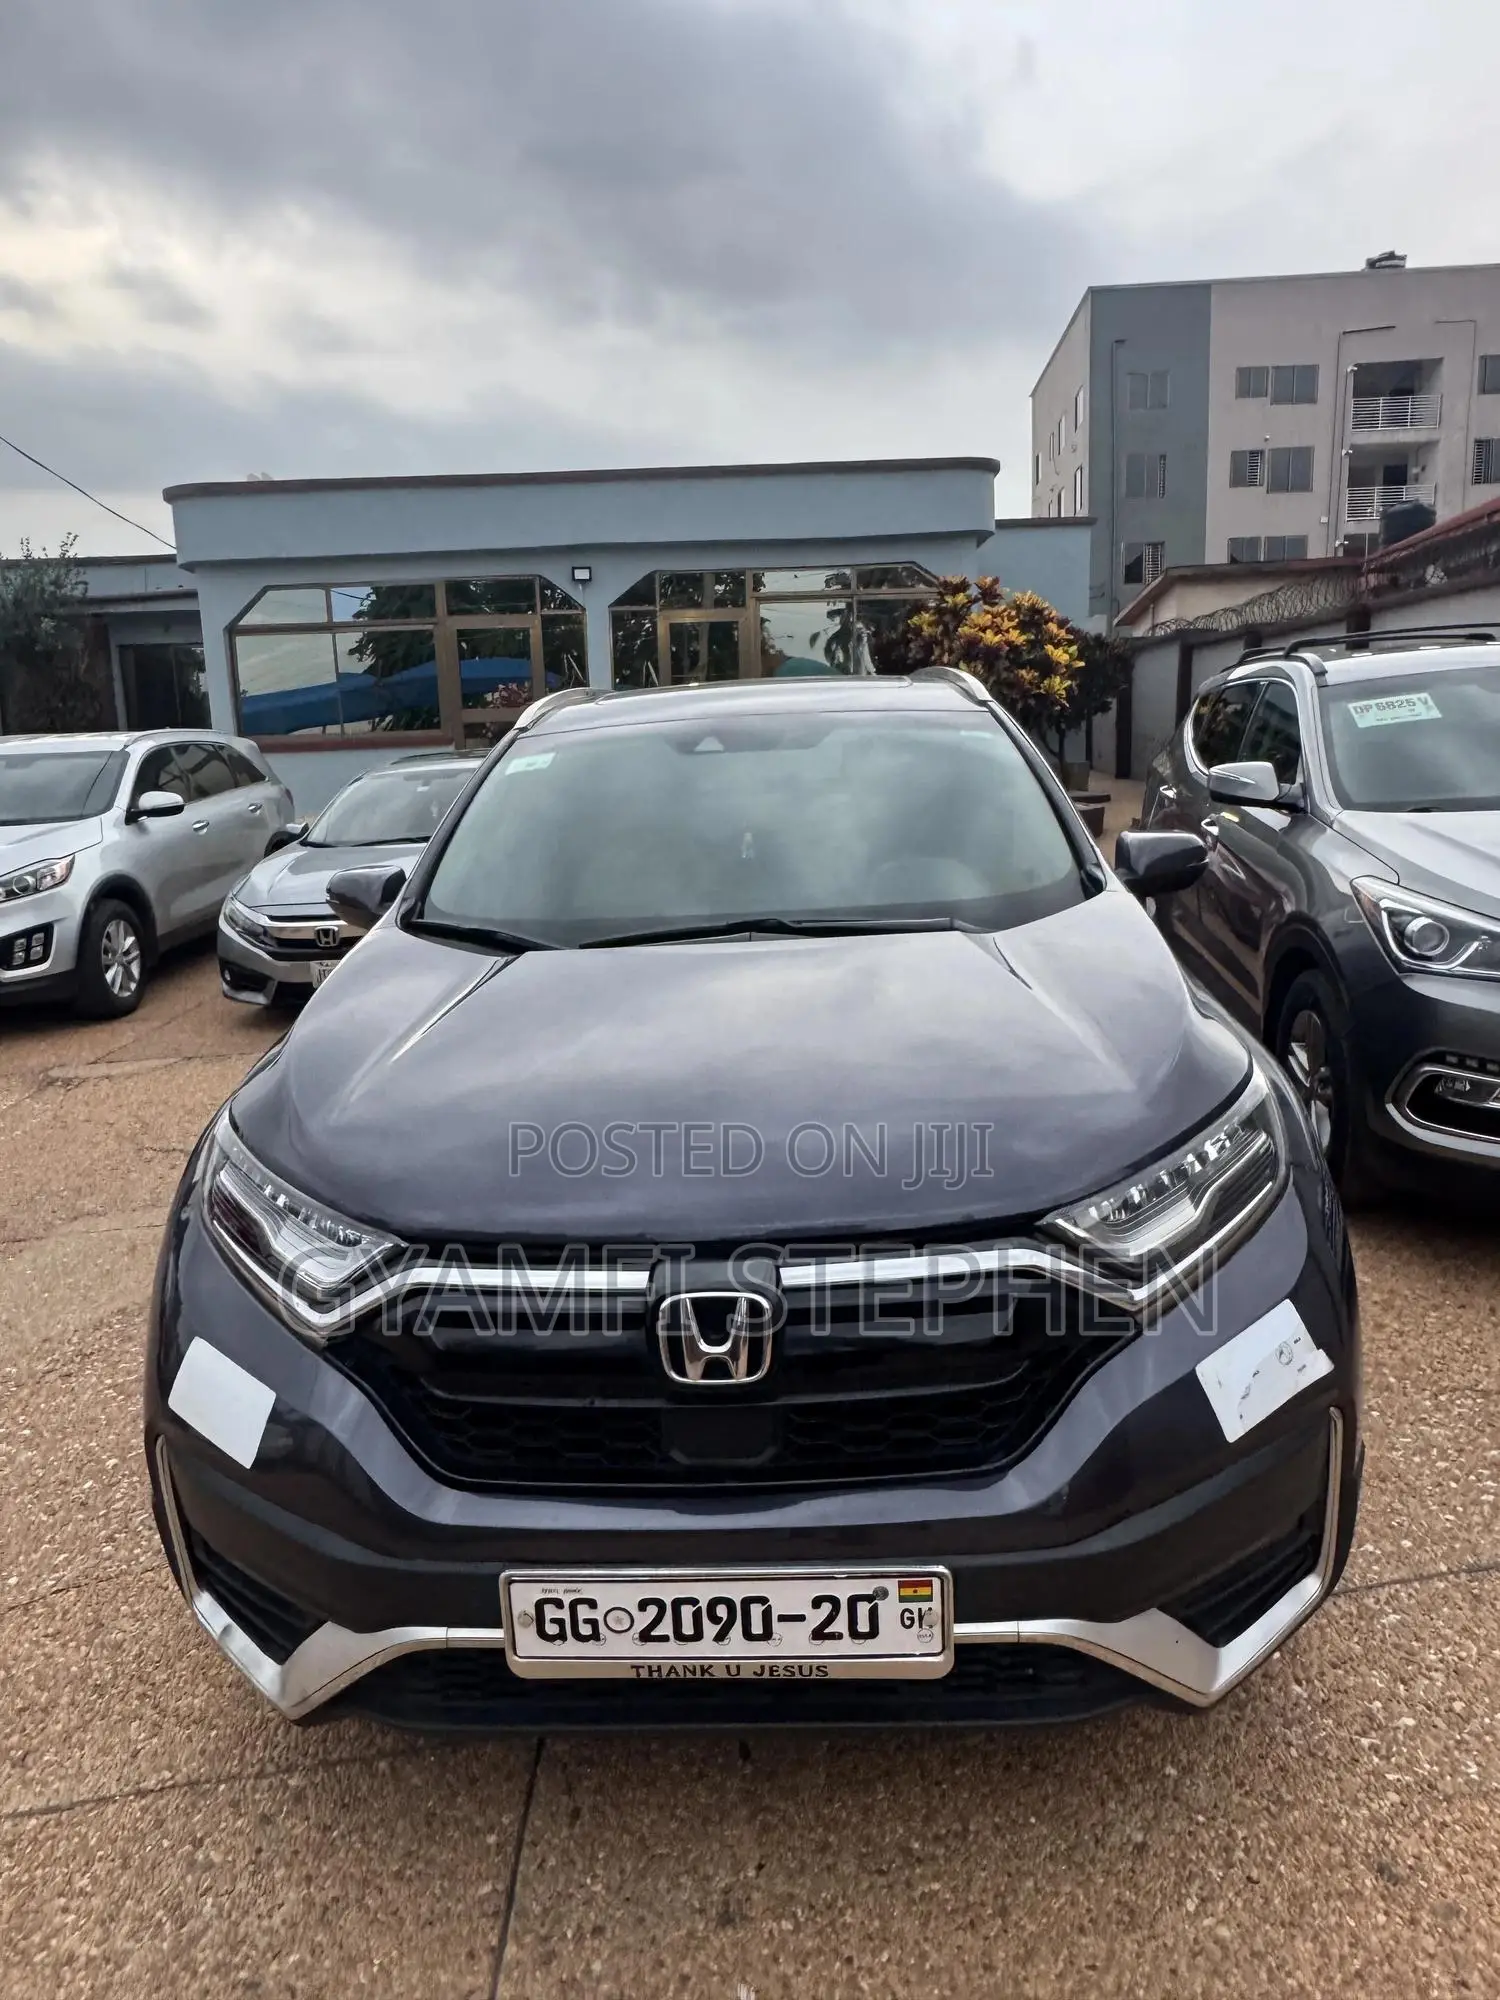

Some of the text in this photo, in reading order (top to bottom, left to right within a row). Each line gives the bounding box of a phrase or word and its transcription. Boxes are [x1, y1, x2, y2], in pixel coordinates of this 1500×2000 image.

[534, 1594, 880, 1643] GG 2090-20
[630, 1664, 829, 1678] THANK U JESUS
